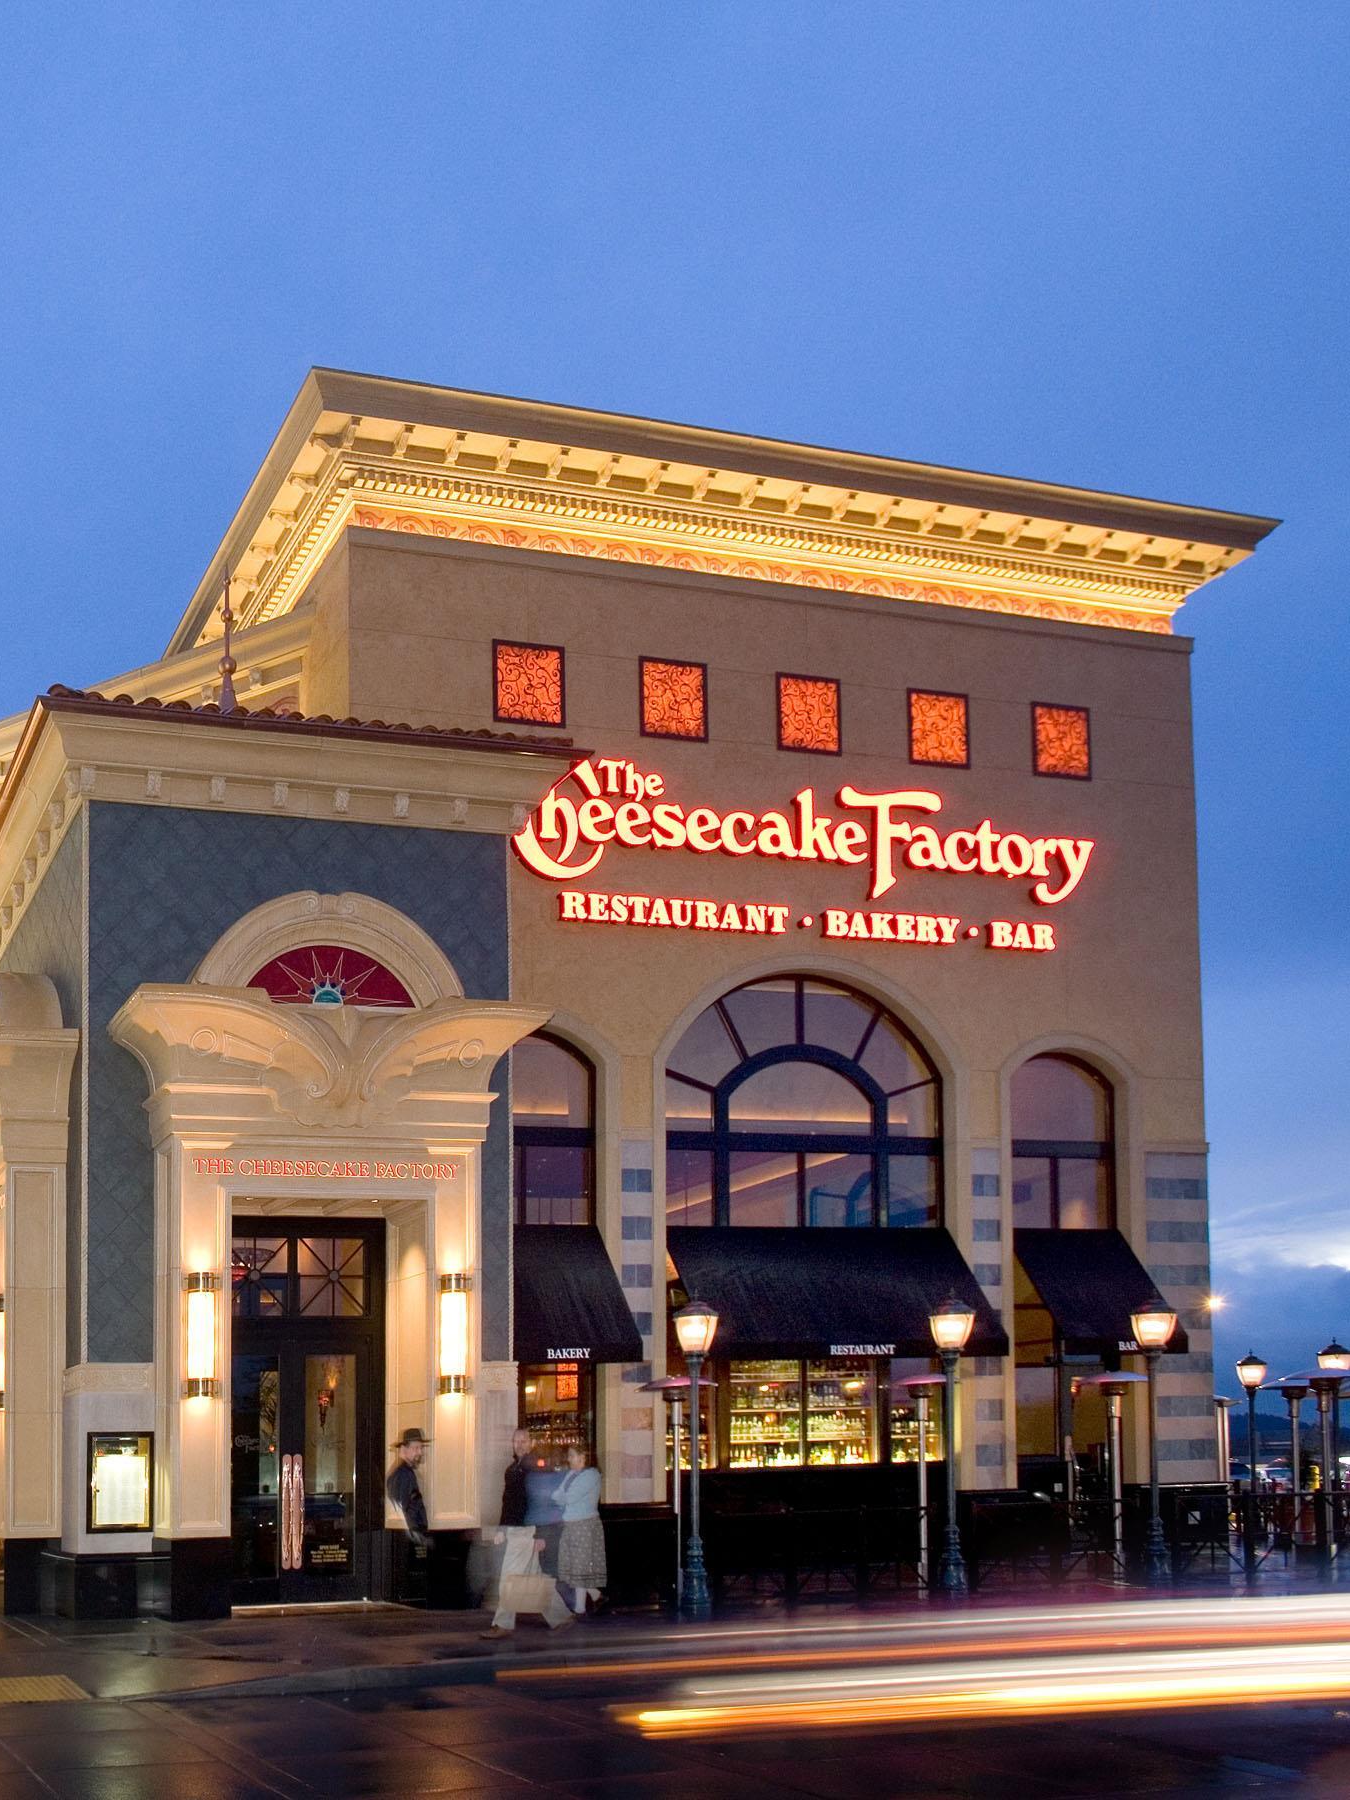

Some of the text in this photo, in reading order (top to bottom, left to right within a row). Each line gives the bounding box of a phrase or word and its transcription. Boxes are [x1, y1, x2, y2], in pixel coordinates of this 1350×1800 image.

[597, 758, 666, 803] The
[511, 759, 1096, 905] Cheesecake Factory
[559, 891, 1057, 952] RESTAURANT BAKERY BAR
[192, 1158, 461, 1181] THE CHEESECAKE FACTORY
[546, 1347, 591, 1359] BAKERY
[830, 1344, 896, 1356] RESTAURANT
[1118, 1340, 1139, 1351] BAR
